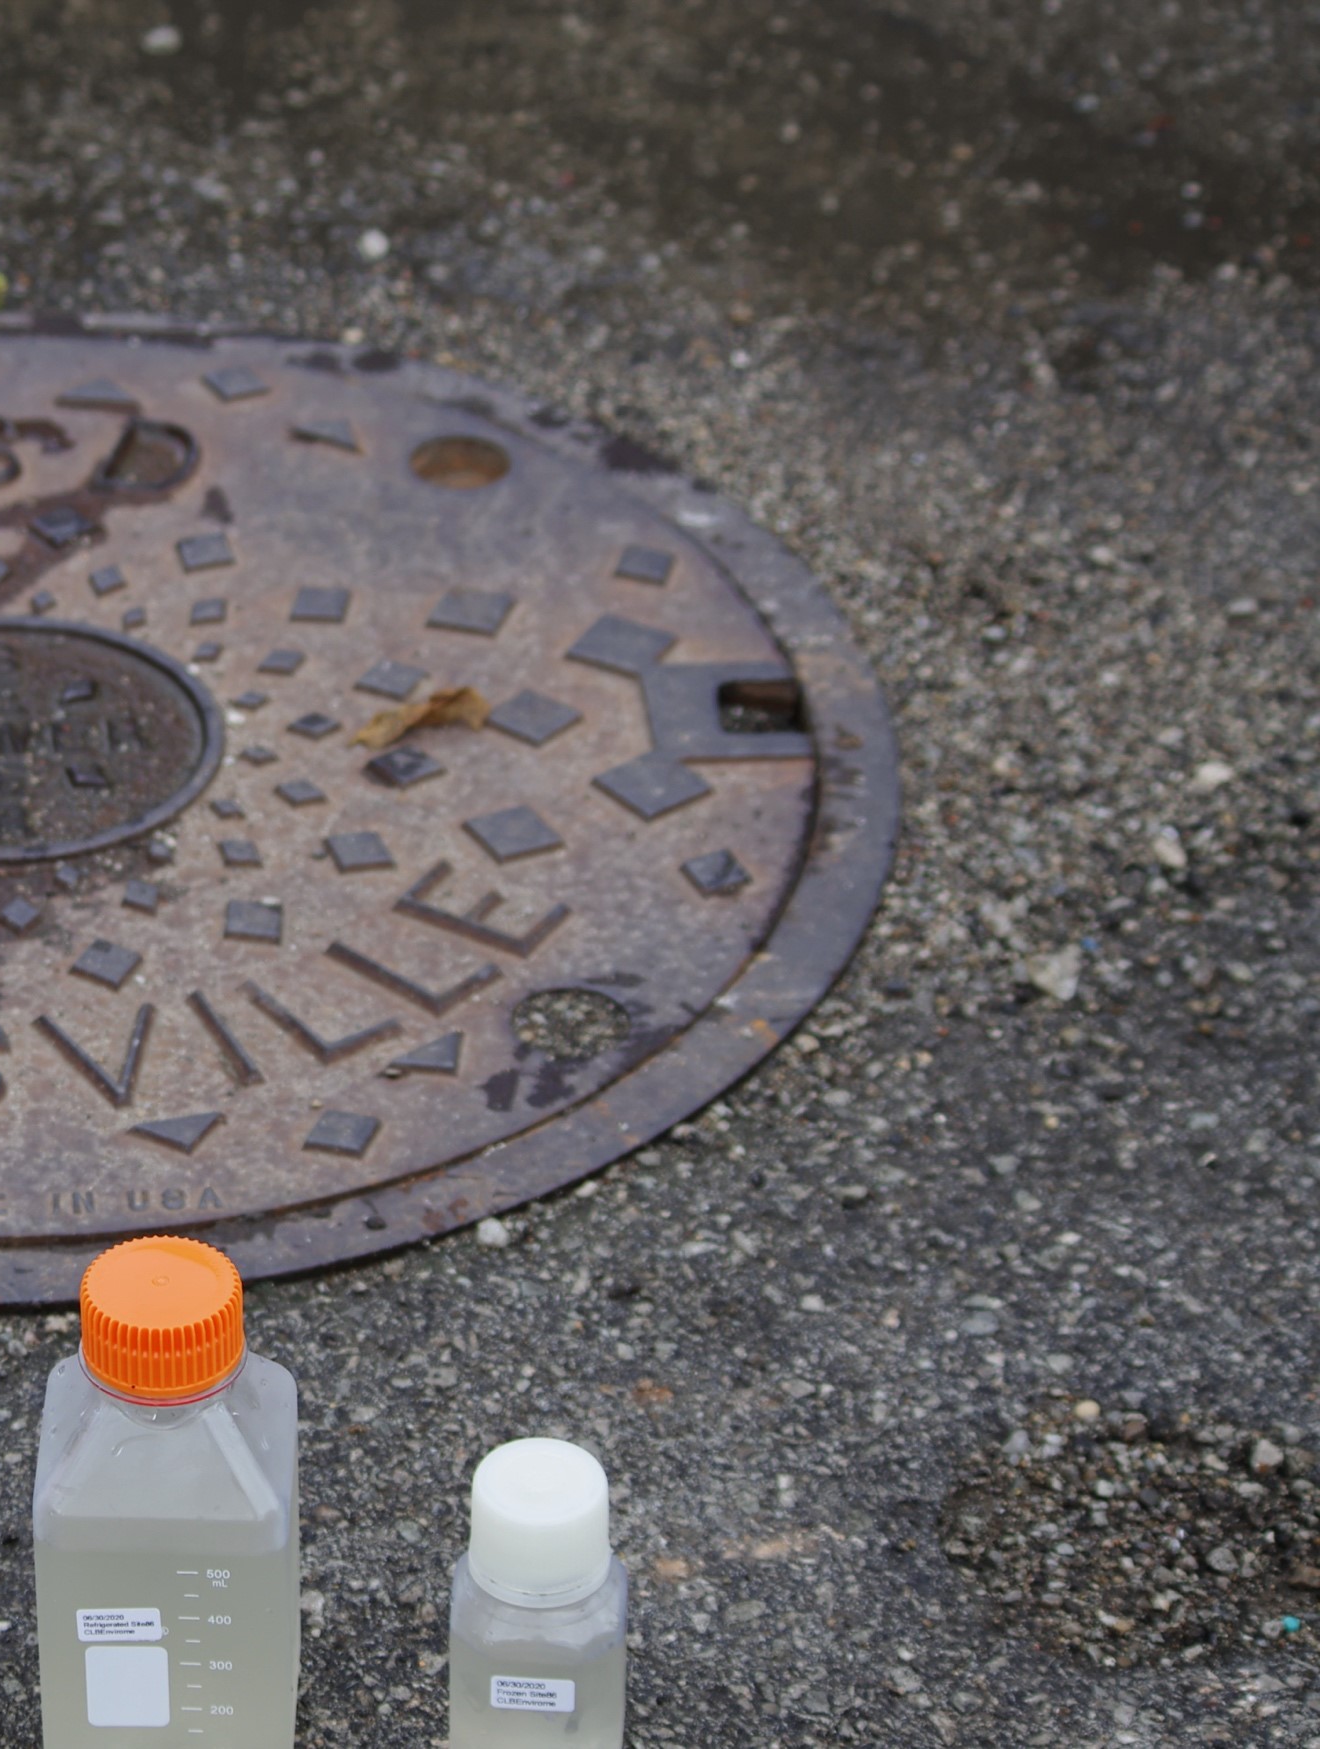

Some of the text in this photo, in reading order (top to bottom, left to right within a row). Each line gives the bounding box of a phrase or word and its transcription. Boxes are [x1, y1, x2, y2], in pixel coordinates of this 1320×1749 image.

[52, 1190, 96, 1215] IN
[127, 1186, 223, 1213] USA
[206, 1569, 231, 1579] 500
[212, 1579, 228, 1588] mL
[207, 1615, 232, 1625] 400
[209, 1660, 233, 1671] 300
[496, 1680, 546, 1690] 06/30/2020
[496, 1688, 527, 1697] Frozen
[210, 1705, 234, 1716] 200
